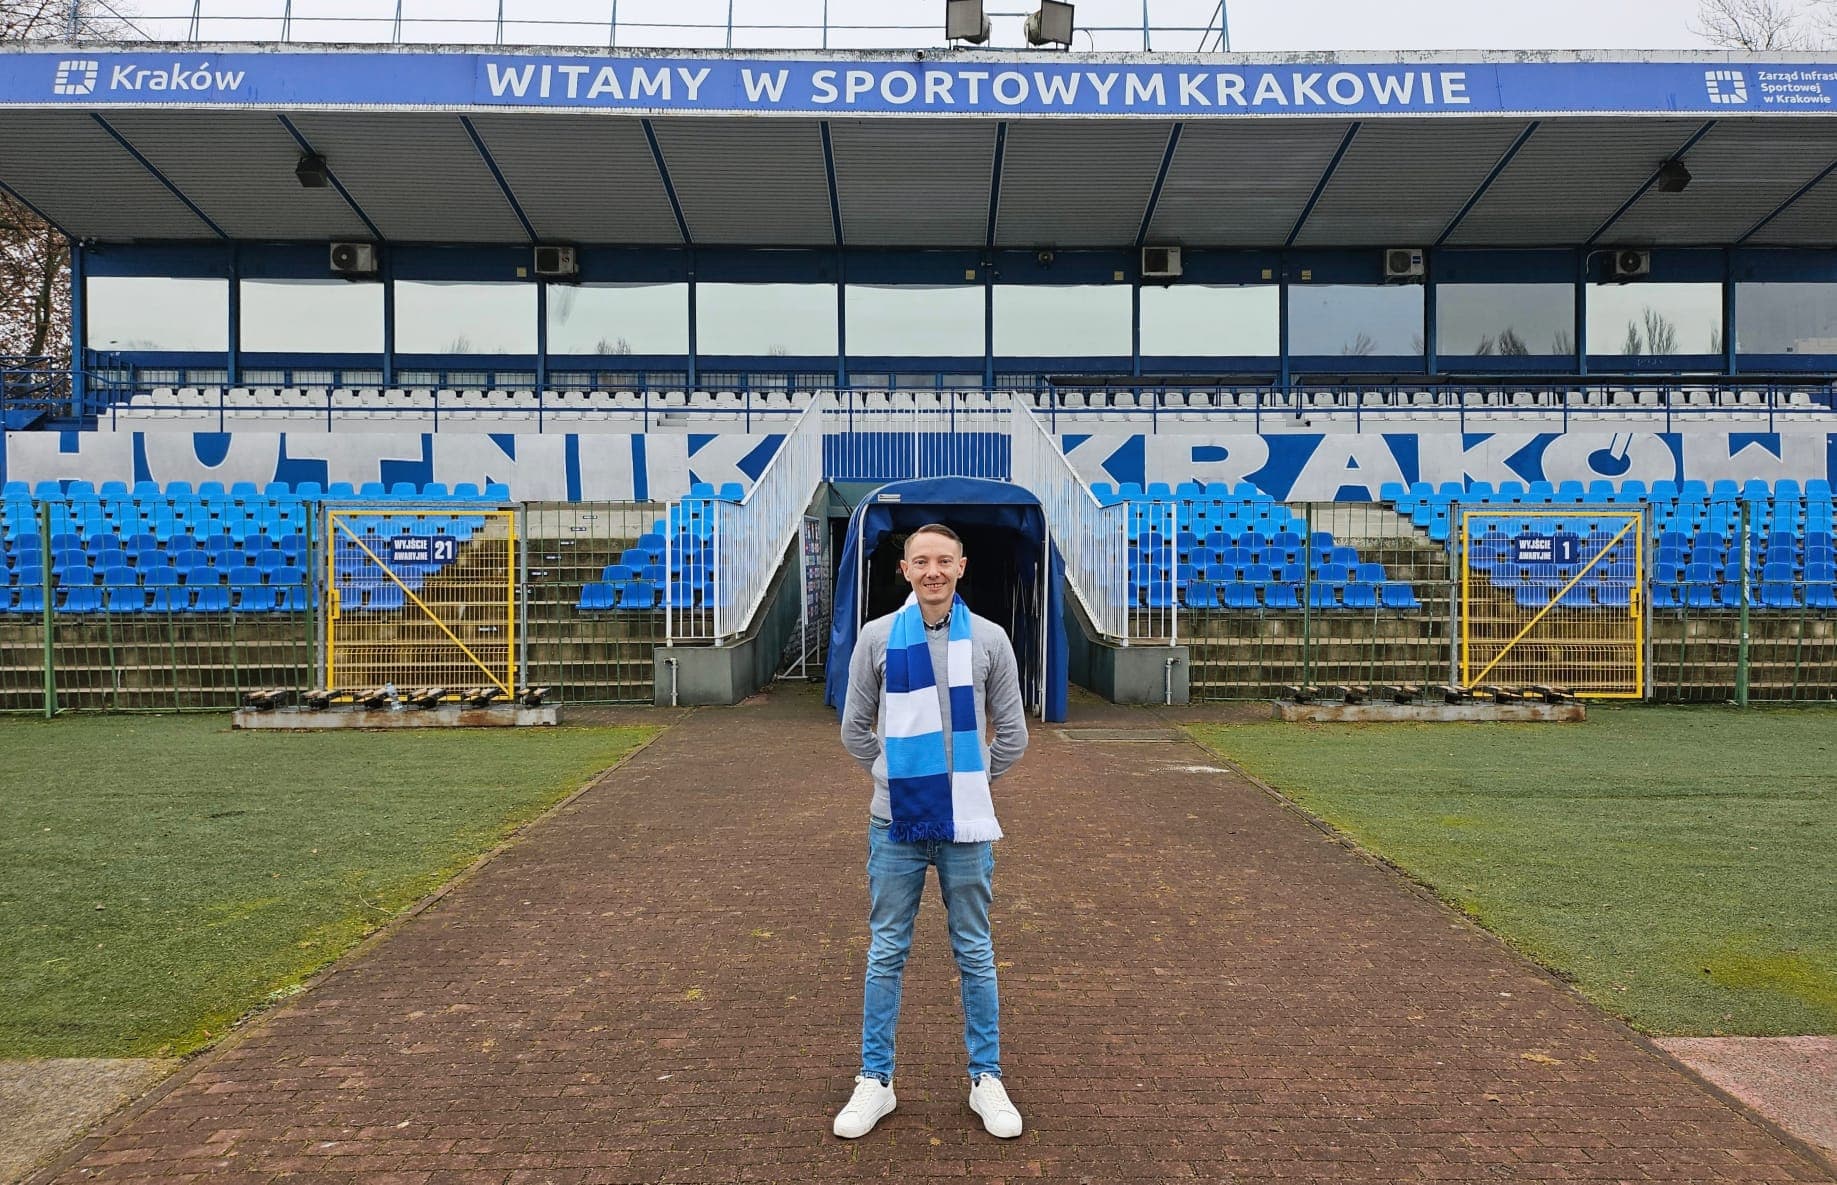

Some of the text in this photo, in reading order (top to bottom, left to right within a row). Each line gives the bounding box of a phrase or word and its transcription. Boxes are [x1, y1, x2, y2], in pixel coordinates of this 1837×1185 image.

[110, 62, 245, 90] Kraków
[1758, 71, 1798, 83] Zarząd
[487, 63, 1471, 106] WITAMY W SPORTOWYM KRAKOWIE
[1760, 82, 1821, 93] Sportowej
[1776, 94, 1832, 104] Krakowie
[6, 432, 770, 502] HUTNIK
[394, 538, 428, 550] WYJŚCIE
[434, 540, 453, 560] 21
[1519, 538, 1551, 550] WYJŚCIE
[1562, 541, 1570, 560] 1
